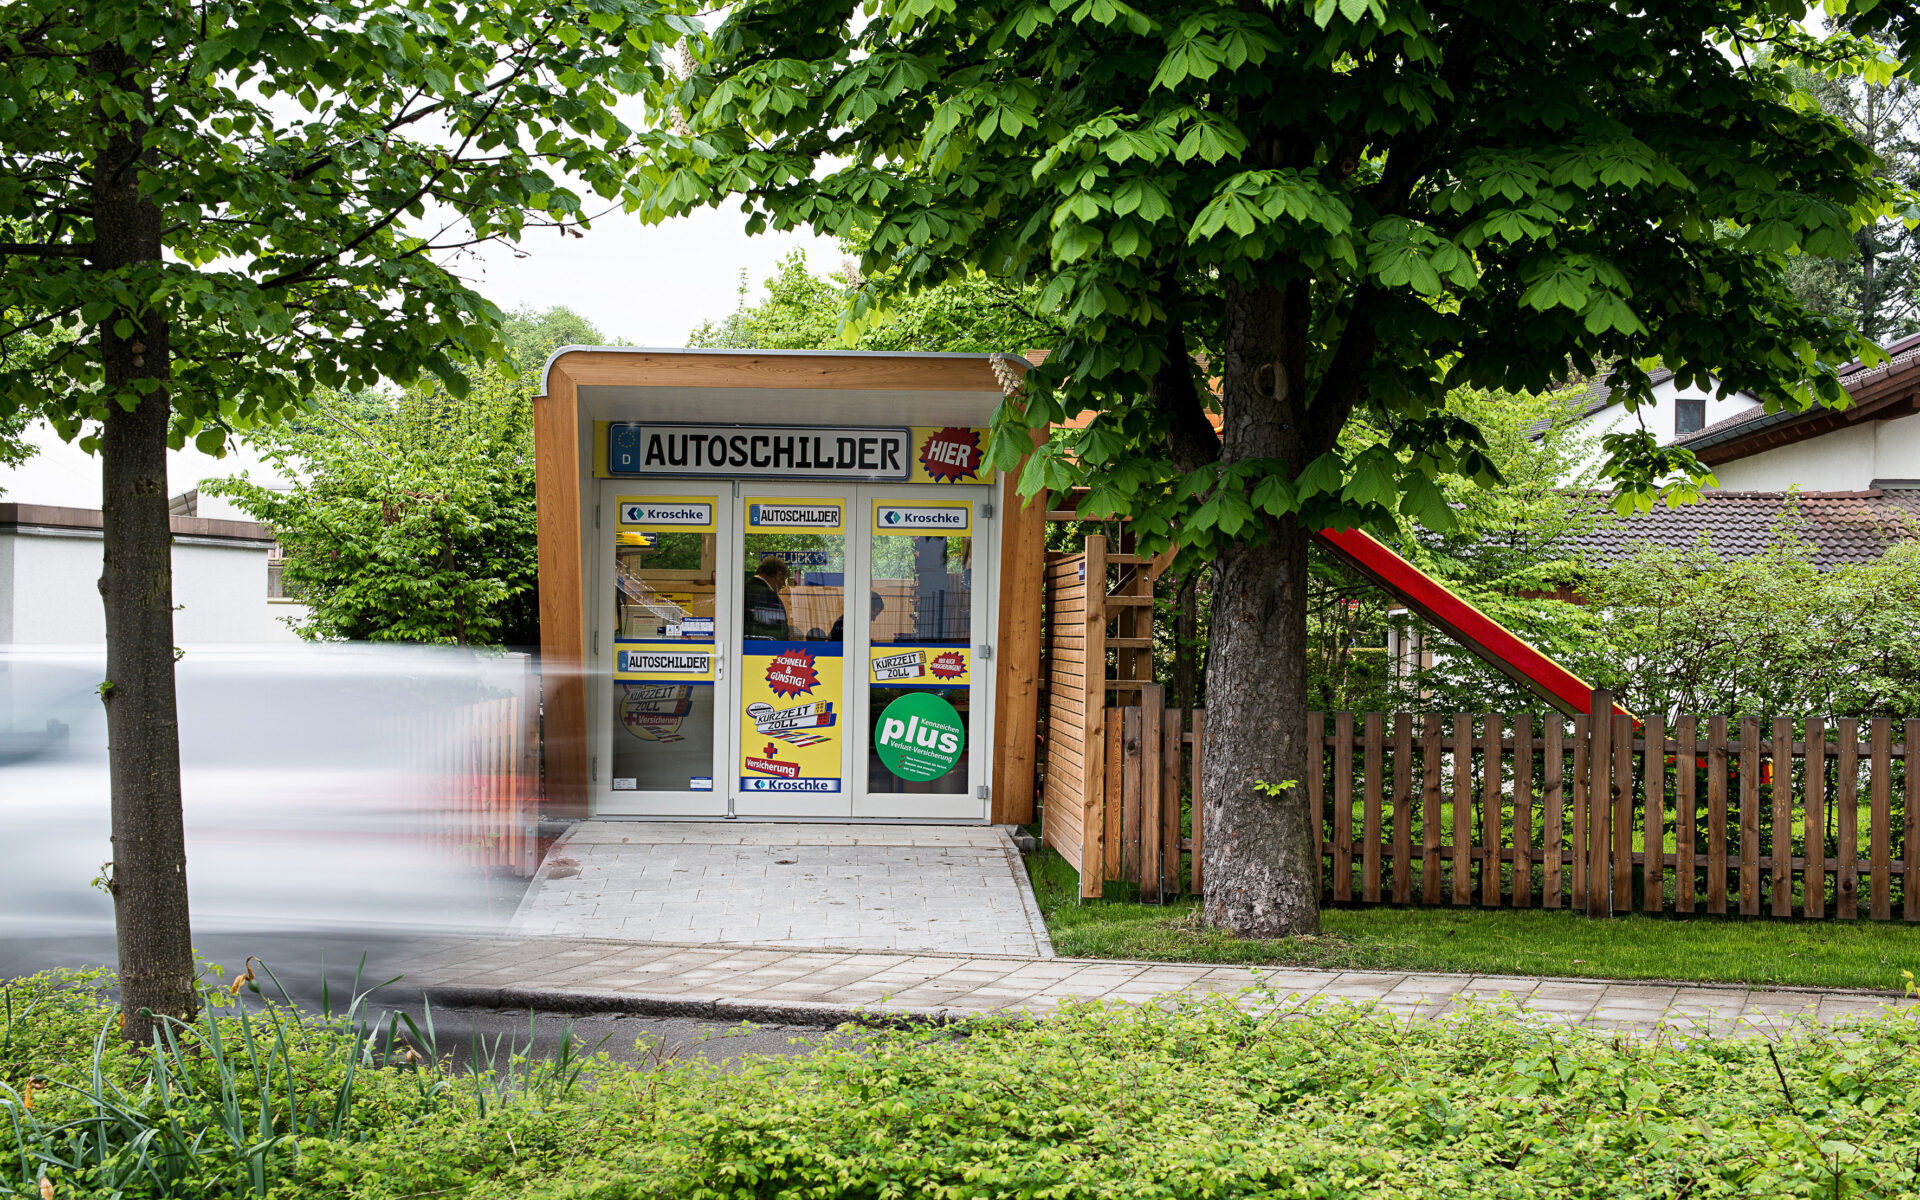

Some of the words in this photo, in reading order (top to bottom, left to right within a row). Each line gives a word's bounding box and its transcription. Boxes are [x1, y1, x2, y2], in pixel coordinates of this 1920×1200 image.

[645, 433, 900, 470] AUTOSCHILDER
[927, 439, 971, 467] HIER
[622, 454, 631, 464] D
[648, 509, 703, 519] Kroschke
[761, 510, 838, 522] AUTOSCHILDER
[904, 513, 960, 523] Kroschke
[629, 656, 706, 668] AUTOSCHILDER
[776, 656, 807, 668] SCHNELL
[876, 654, 916, 669] KURZZEIT
[785, 666, 792, 674] &
[887, 668, 909, 677] ZOLL
[770, 671, 805, 687] GÜNSTIG!
[630, 686, 675, 700] KURZZEIT
[635, 701, 660, 711] ZOLL
[639, 715, 678, 724] Versicherung
[757, 705, 811, 723] KURZZEIT
[768, 719, 798, 730] ZOLL
[920, 718, 959, 733] Kennzeichen
[880, 715, 958, 753] plus
[890, 741, 952, 763] Verlust-Versicherung
[747, 758, 795, 777] Versicherung
[769, 780, 828, 790] Kroschke
